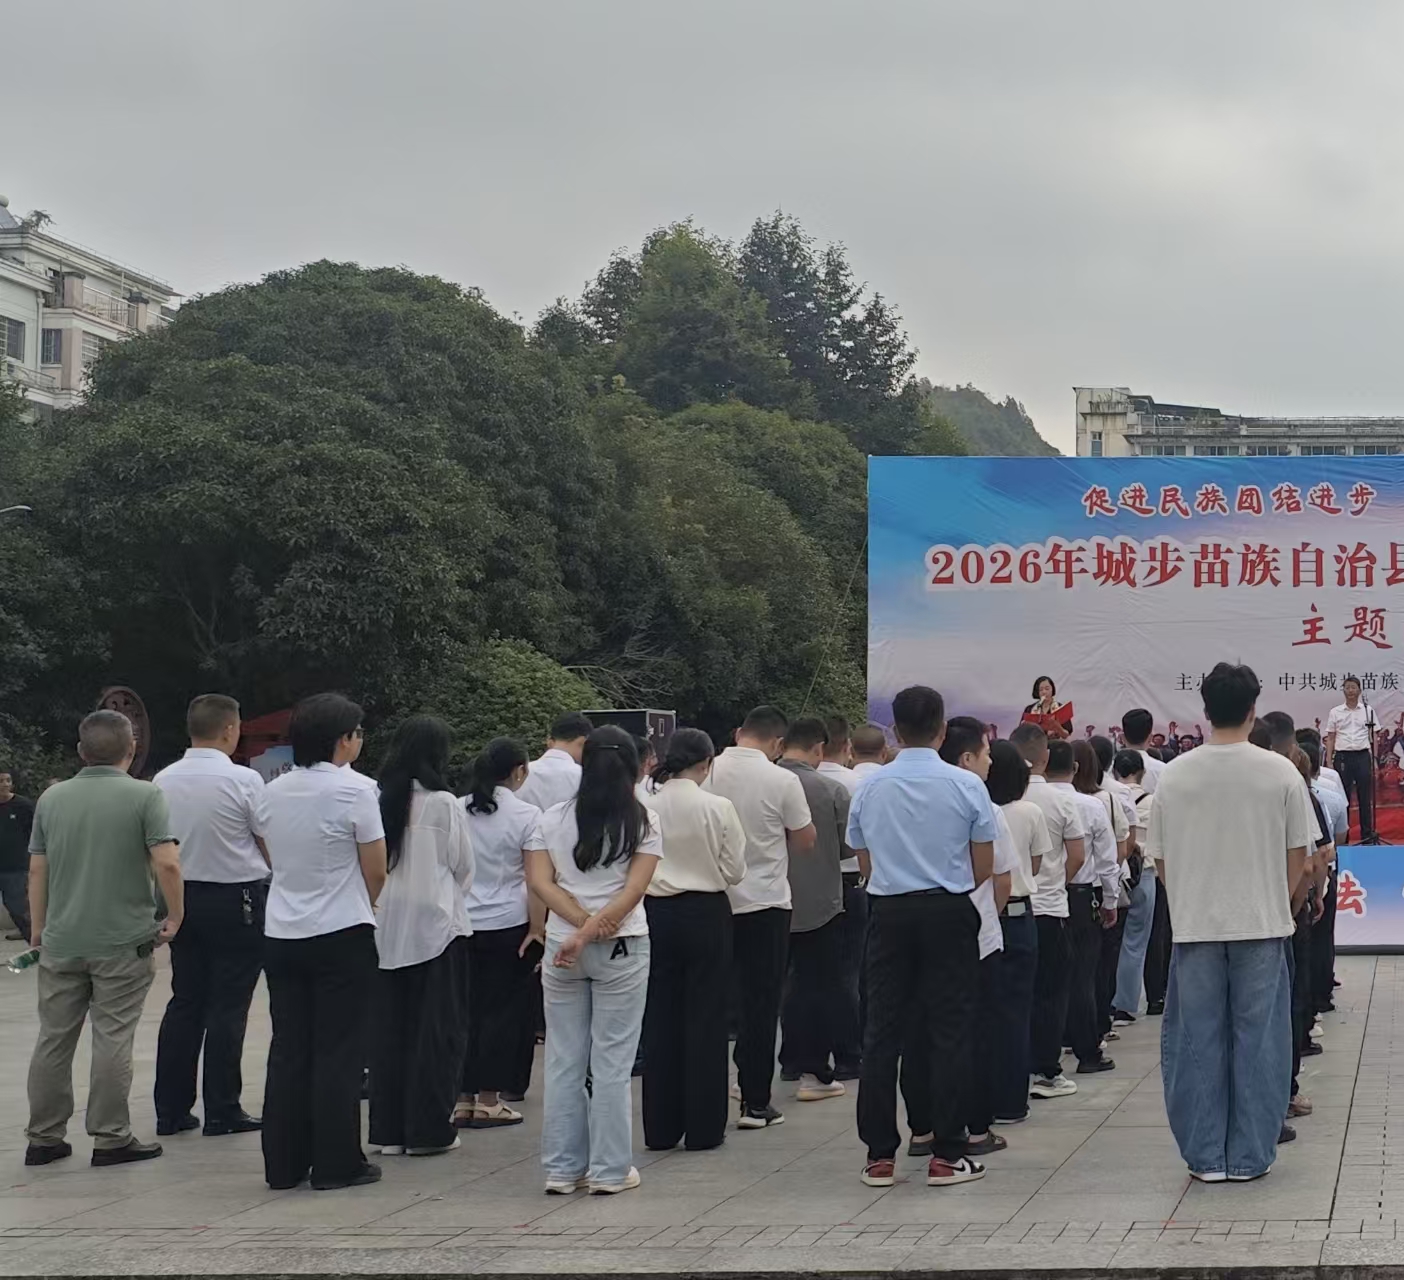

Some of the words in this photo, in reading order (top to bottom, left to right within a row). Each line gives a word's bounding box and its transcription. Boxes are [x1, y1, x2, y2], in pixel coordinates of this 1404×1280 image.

[1083, 484, 1373, 517] 促进民族团结进步
[609, 937, 629, 960] A
